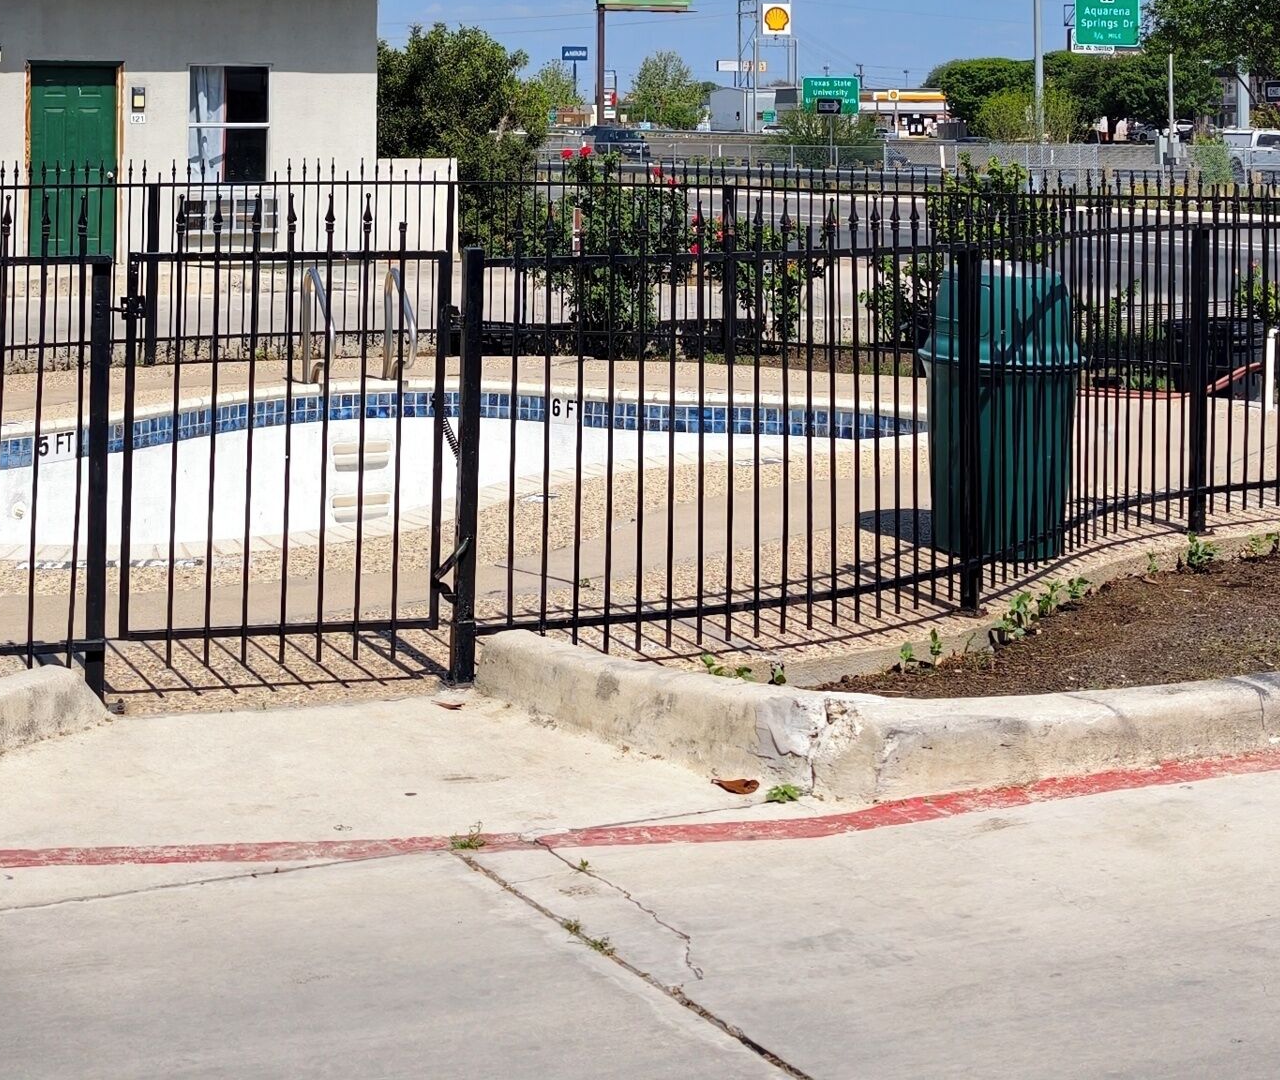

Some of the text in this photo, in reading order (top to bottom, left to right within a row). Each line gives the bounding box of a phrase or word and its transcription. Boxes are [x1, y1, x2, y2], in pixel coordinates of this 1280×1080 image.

[1084, 7, 1130, 17] Aquarena
[1081, 19, 1134, 30] Springs Dr
[813, 89, 848, 97] University
[553, 398, 561, 416] 6
[39, 431, 74, 456] 5 FT
